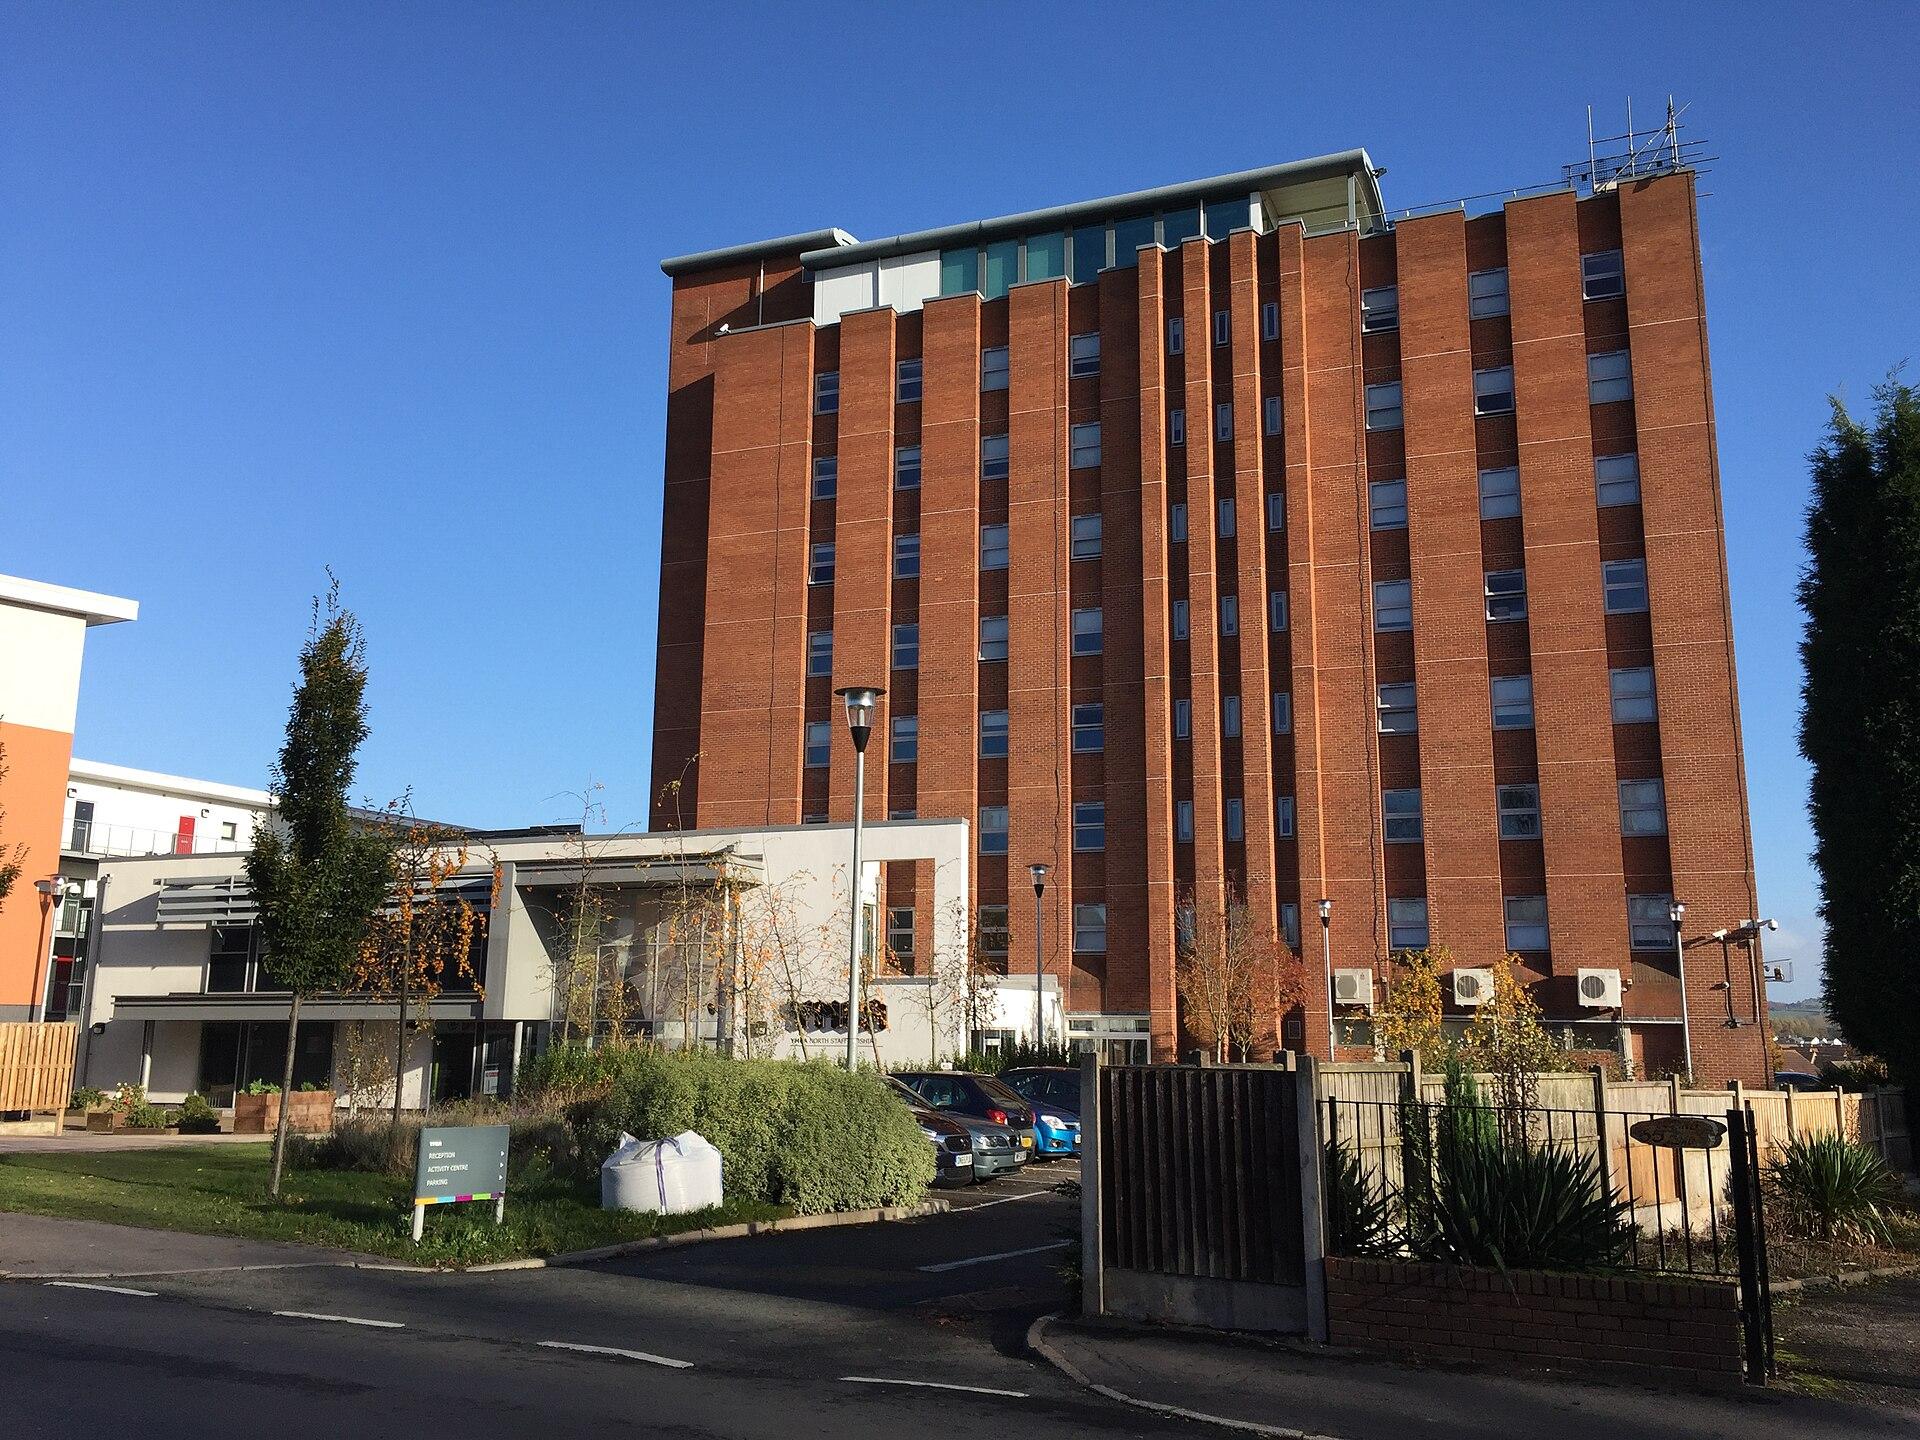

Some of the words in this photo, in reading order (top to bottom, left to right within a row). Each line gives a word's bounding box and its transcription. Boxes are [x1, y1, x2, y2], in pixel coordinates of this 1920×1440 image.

[428, 1152, 456, 1160] RECEPTION
[427, 1165, 450, 1173] ACTIVITY
[450, 1164, 469, 1172] CENTRE
[426, 1179, 448, 1187] PARKING
